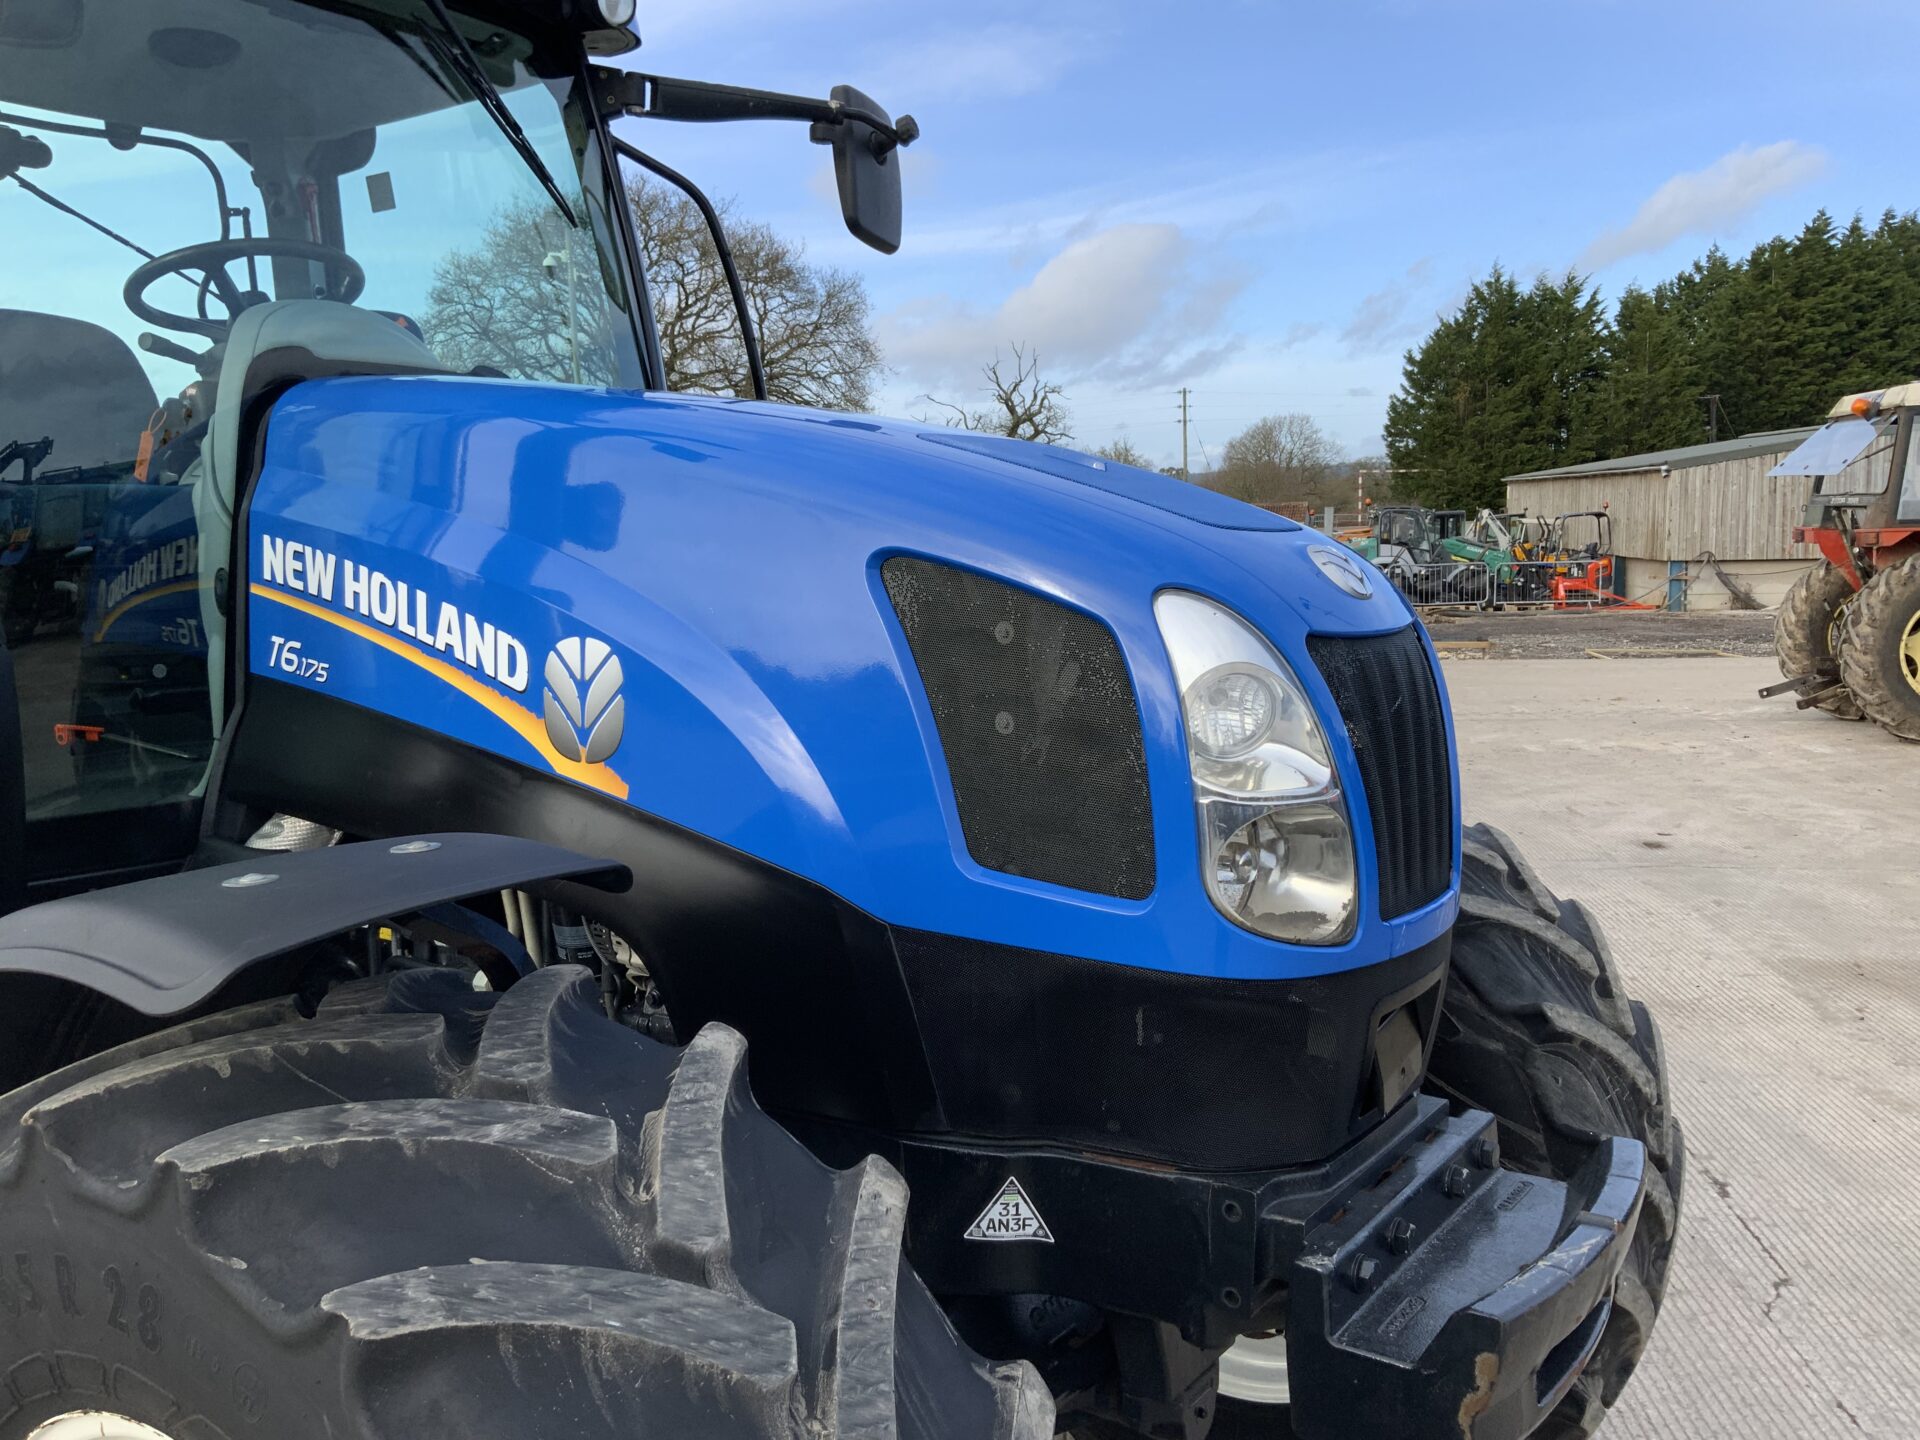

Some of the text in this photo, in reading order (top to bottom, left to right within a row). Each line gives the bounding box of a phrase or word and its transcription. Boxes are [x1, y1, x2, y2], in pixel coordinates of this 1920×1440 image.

[263, 534, 529, 692] NEW HOLLAND
[269, 635, 330, 683] T6.175
[986, 1217, 1034, 1232] AN3F
[999, 1202, 1021, 1217] 31
[102, 1265, 162, 1353] 28
